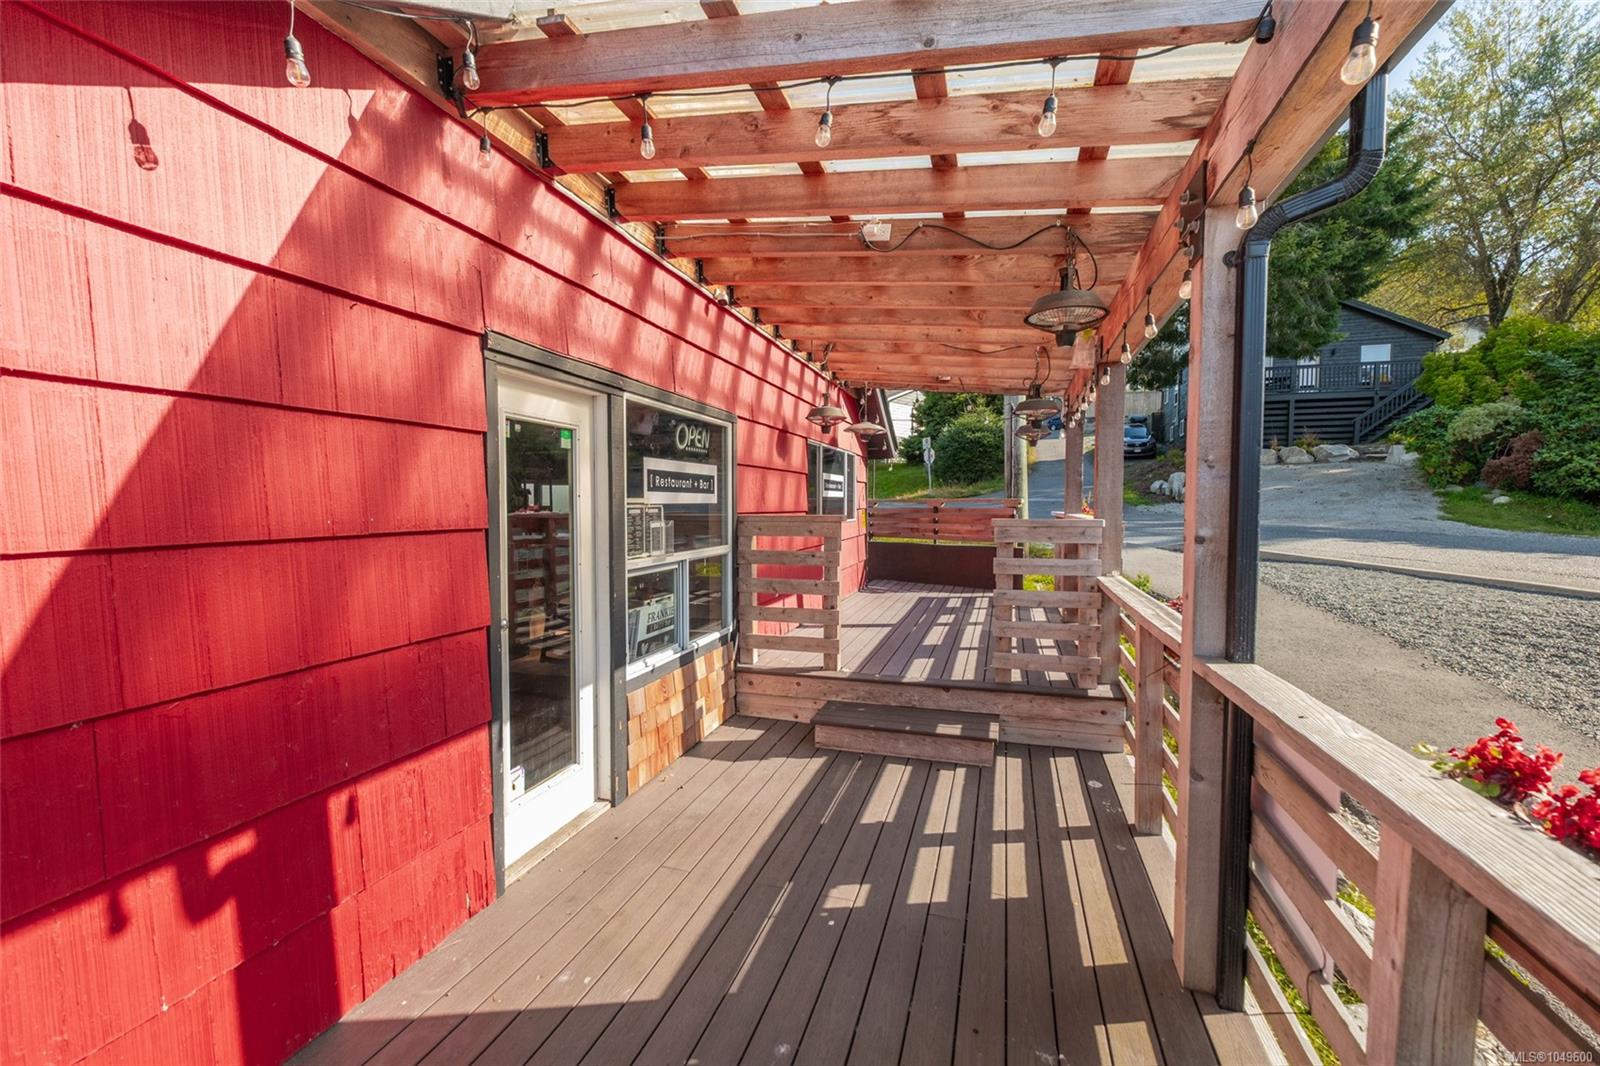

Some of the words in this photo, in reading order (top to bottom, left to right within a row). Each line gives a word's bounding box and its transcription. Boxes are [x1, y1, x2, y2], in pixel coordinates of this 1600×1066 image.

[676, 422, 710, 449] OPEN
[655, 475, 692, 489] Restaurant
[699, 479, 709, 490] Bar
